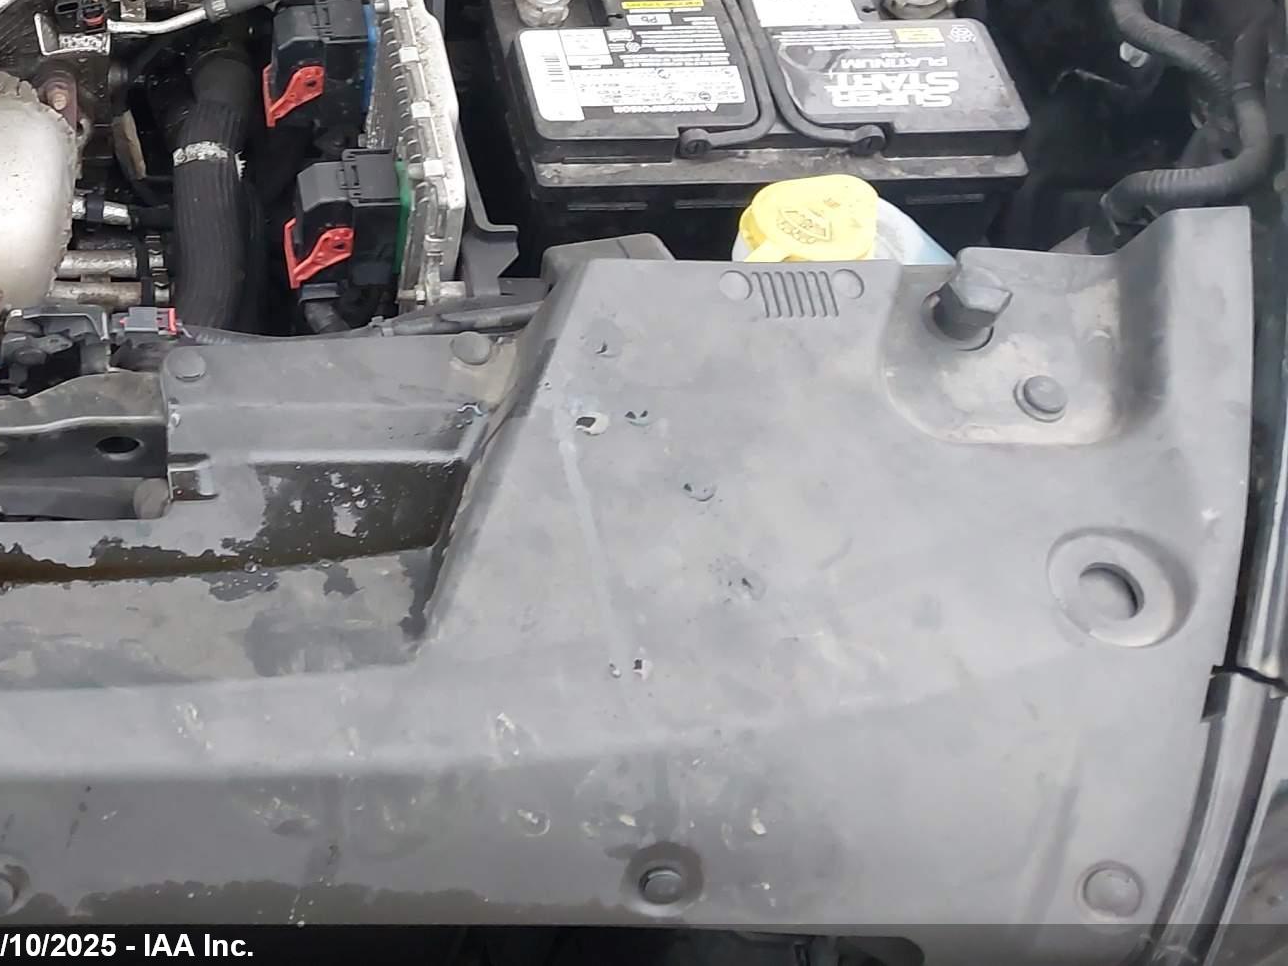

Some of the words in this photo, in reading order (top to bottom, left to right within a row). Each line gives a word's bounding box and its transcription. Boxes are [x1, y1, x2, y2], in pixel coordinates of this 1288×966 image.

[840, 56, 948, 68] PLATINUM
[824, 71, 960, 94] START
[832, 90, 953, 107] SUPER
